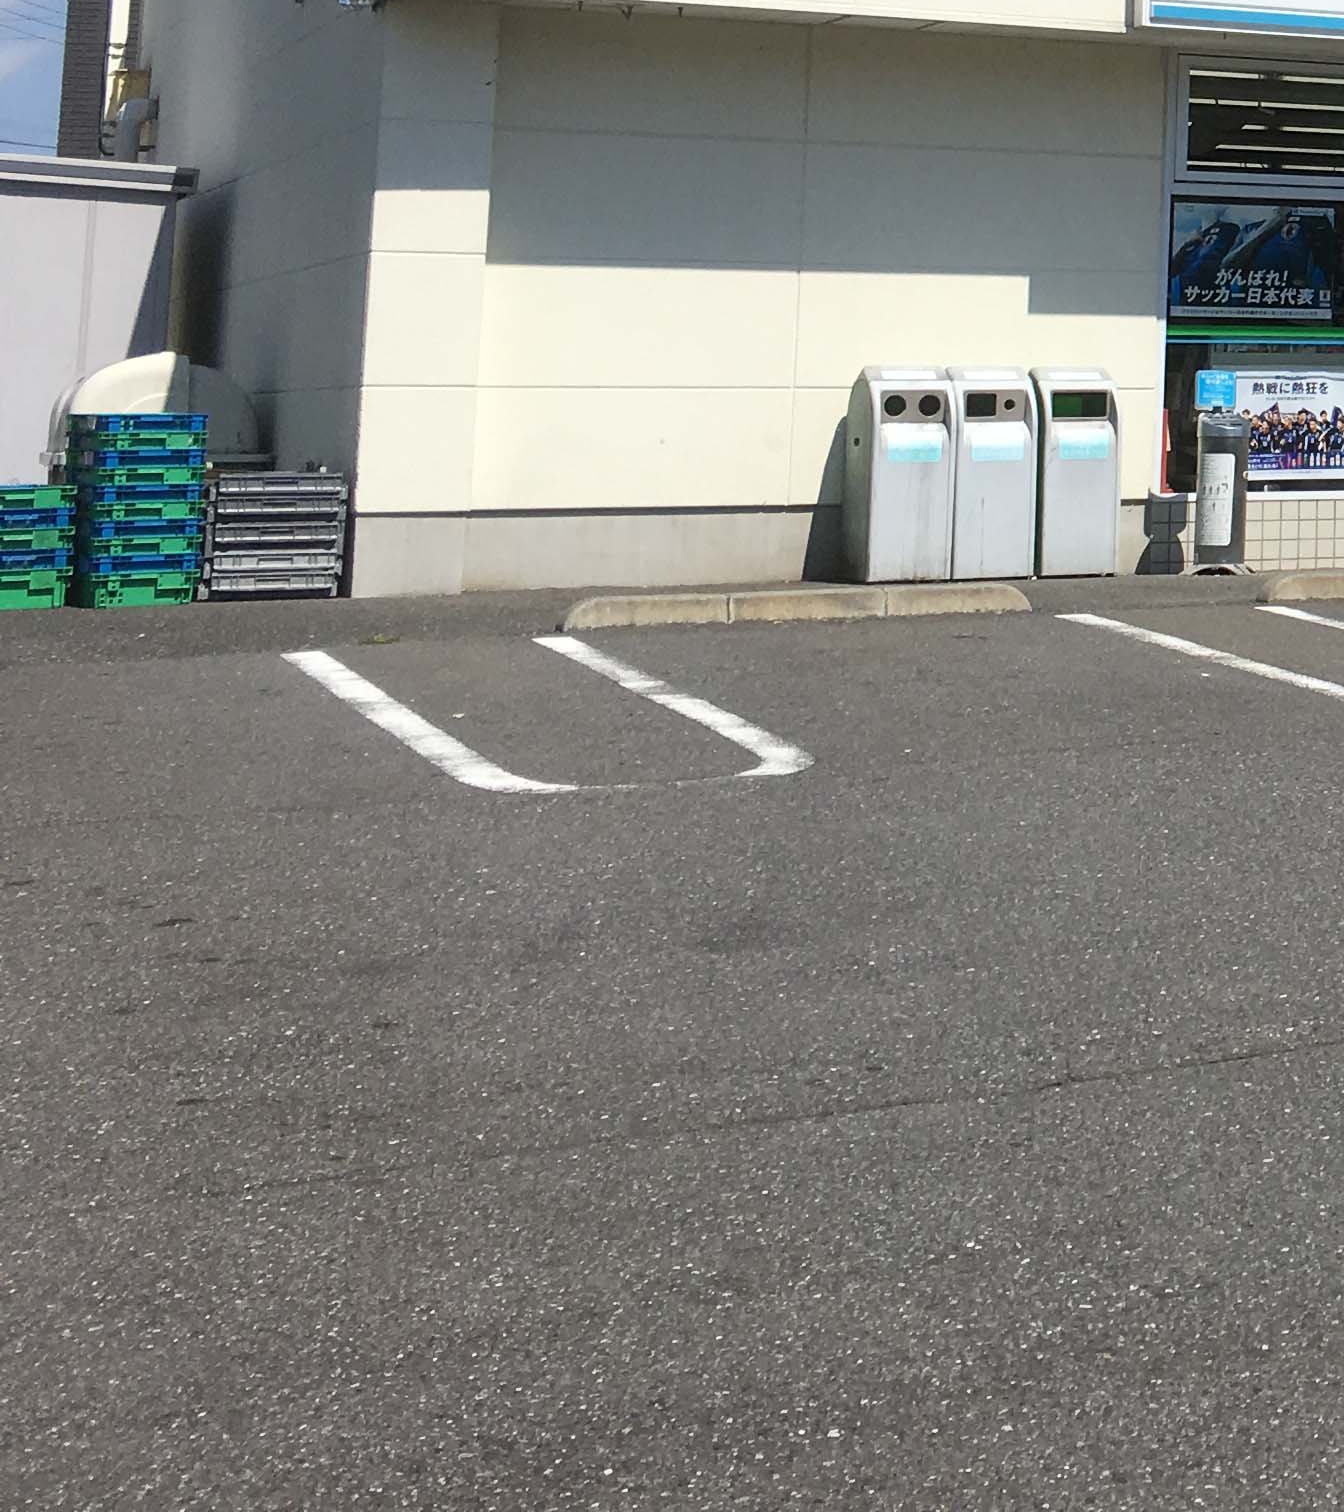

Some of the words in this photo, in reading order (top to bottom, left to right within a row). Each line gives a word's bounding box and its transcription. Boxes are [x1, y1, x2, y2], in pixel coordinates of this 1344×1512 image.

[1185, 287, 1315, 305] サッカー日本代表
